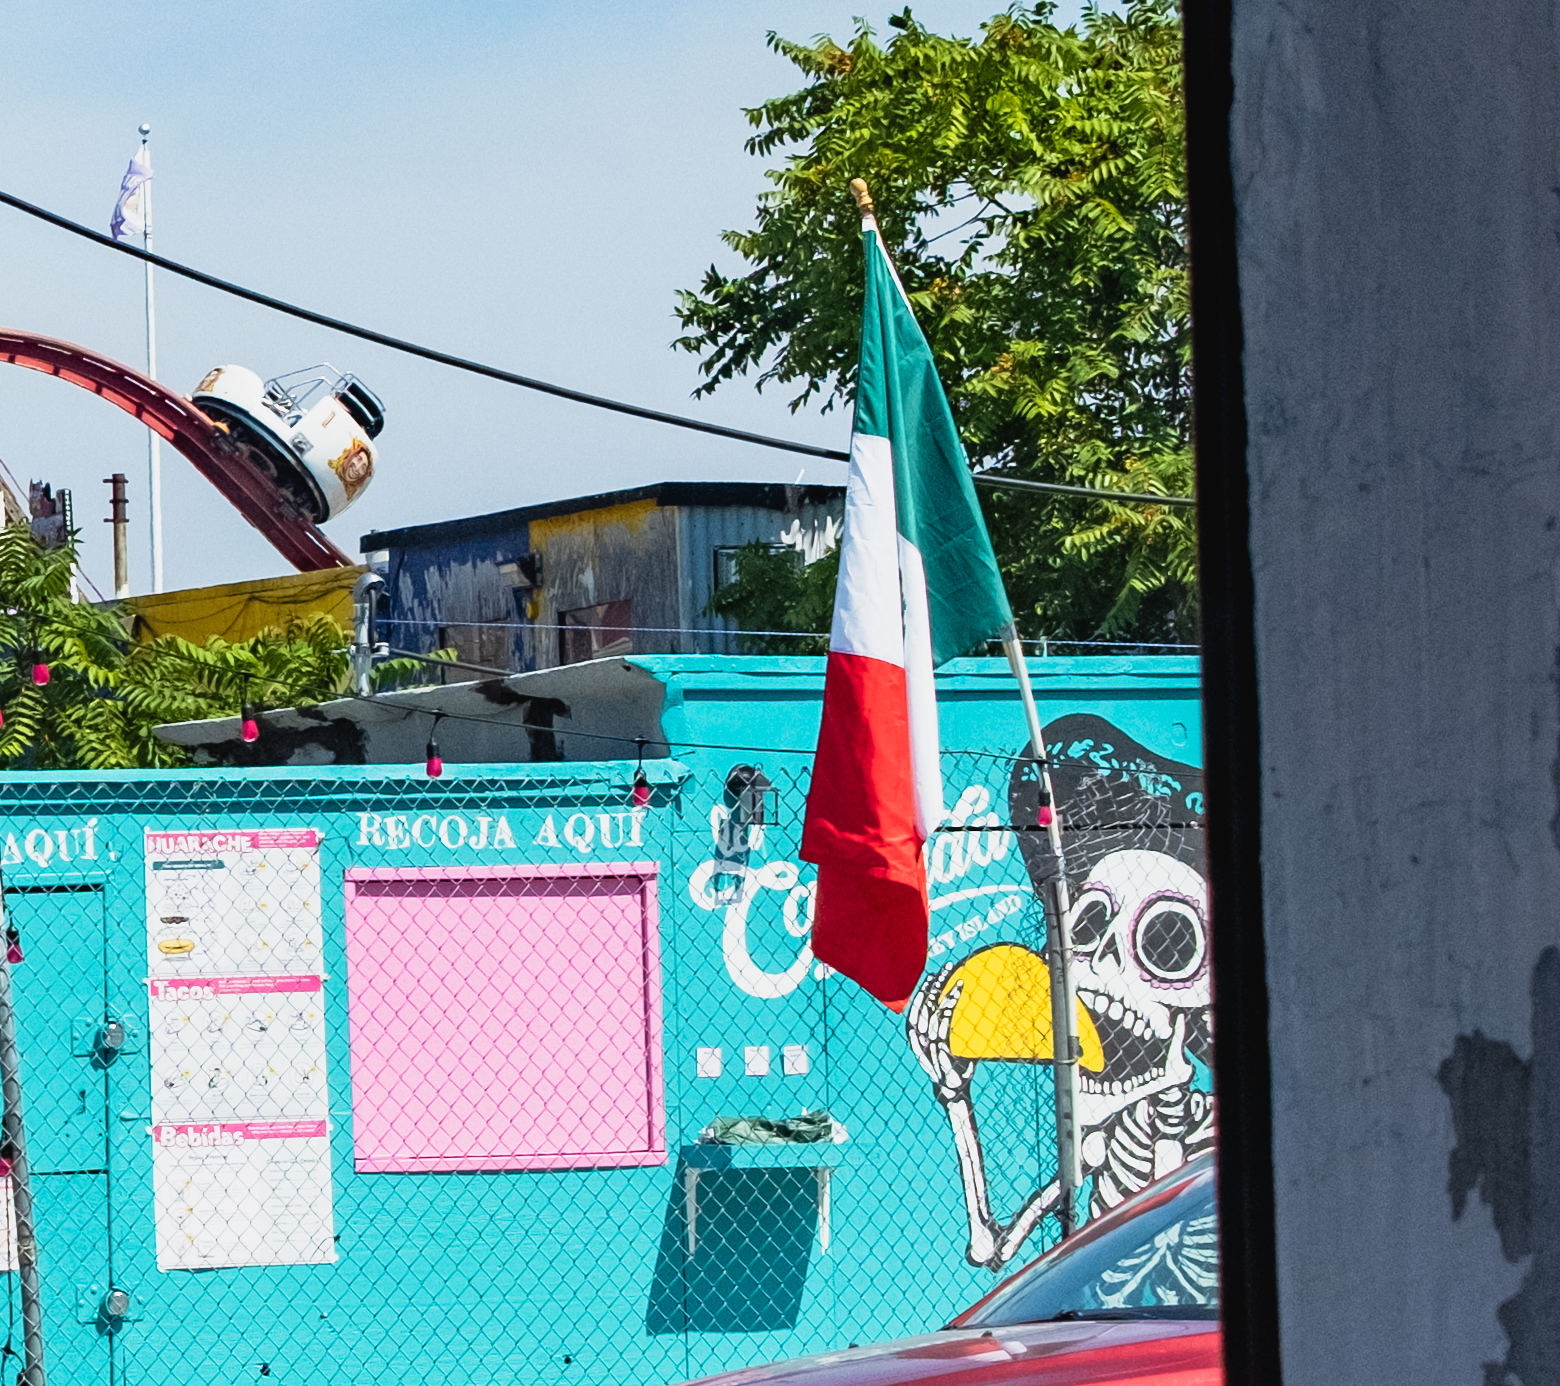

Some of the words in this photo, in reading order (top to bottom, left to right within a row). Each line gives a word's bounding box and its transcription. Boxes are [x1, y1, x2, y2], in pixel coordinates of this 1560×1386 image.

[355, 812, 517, 849] RECOJA
[954, 894, 1022, 943] ISLAND
[154, 980, 215, 1002] Tacos
[160, 1126, 245, 1148] Bebidas
